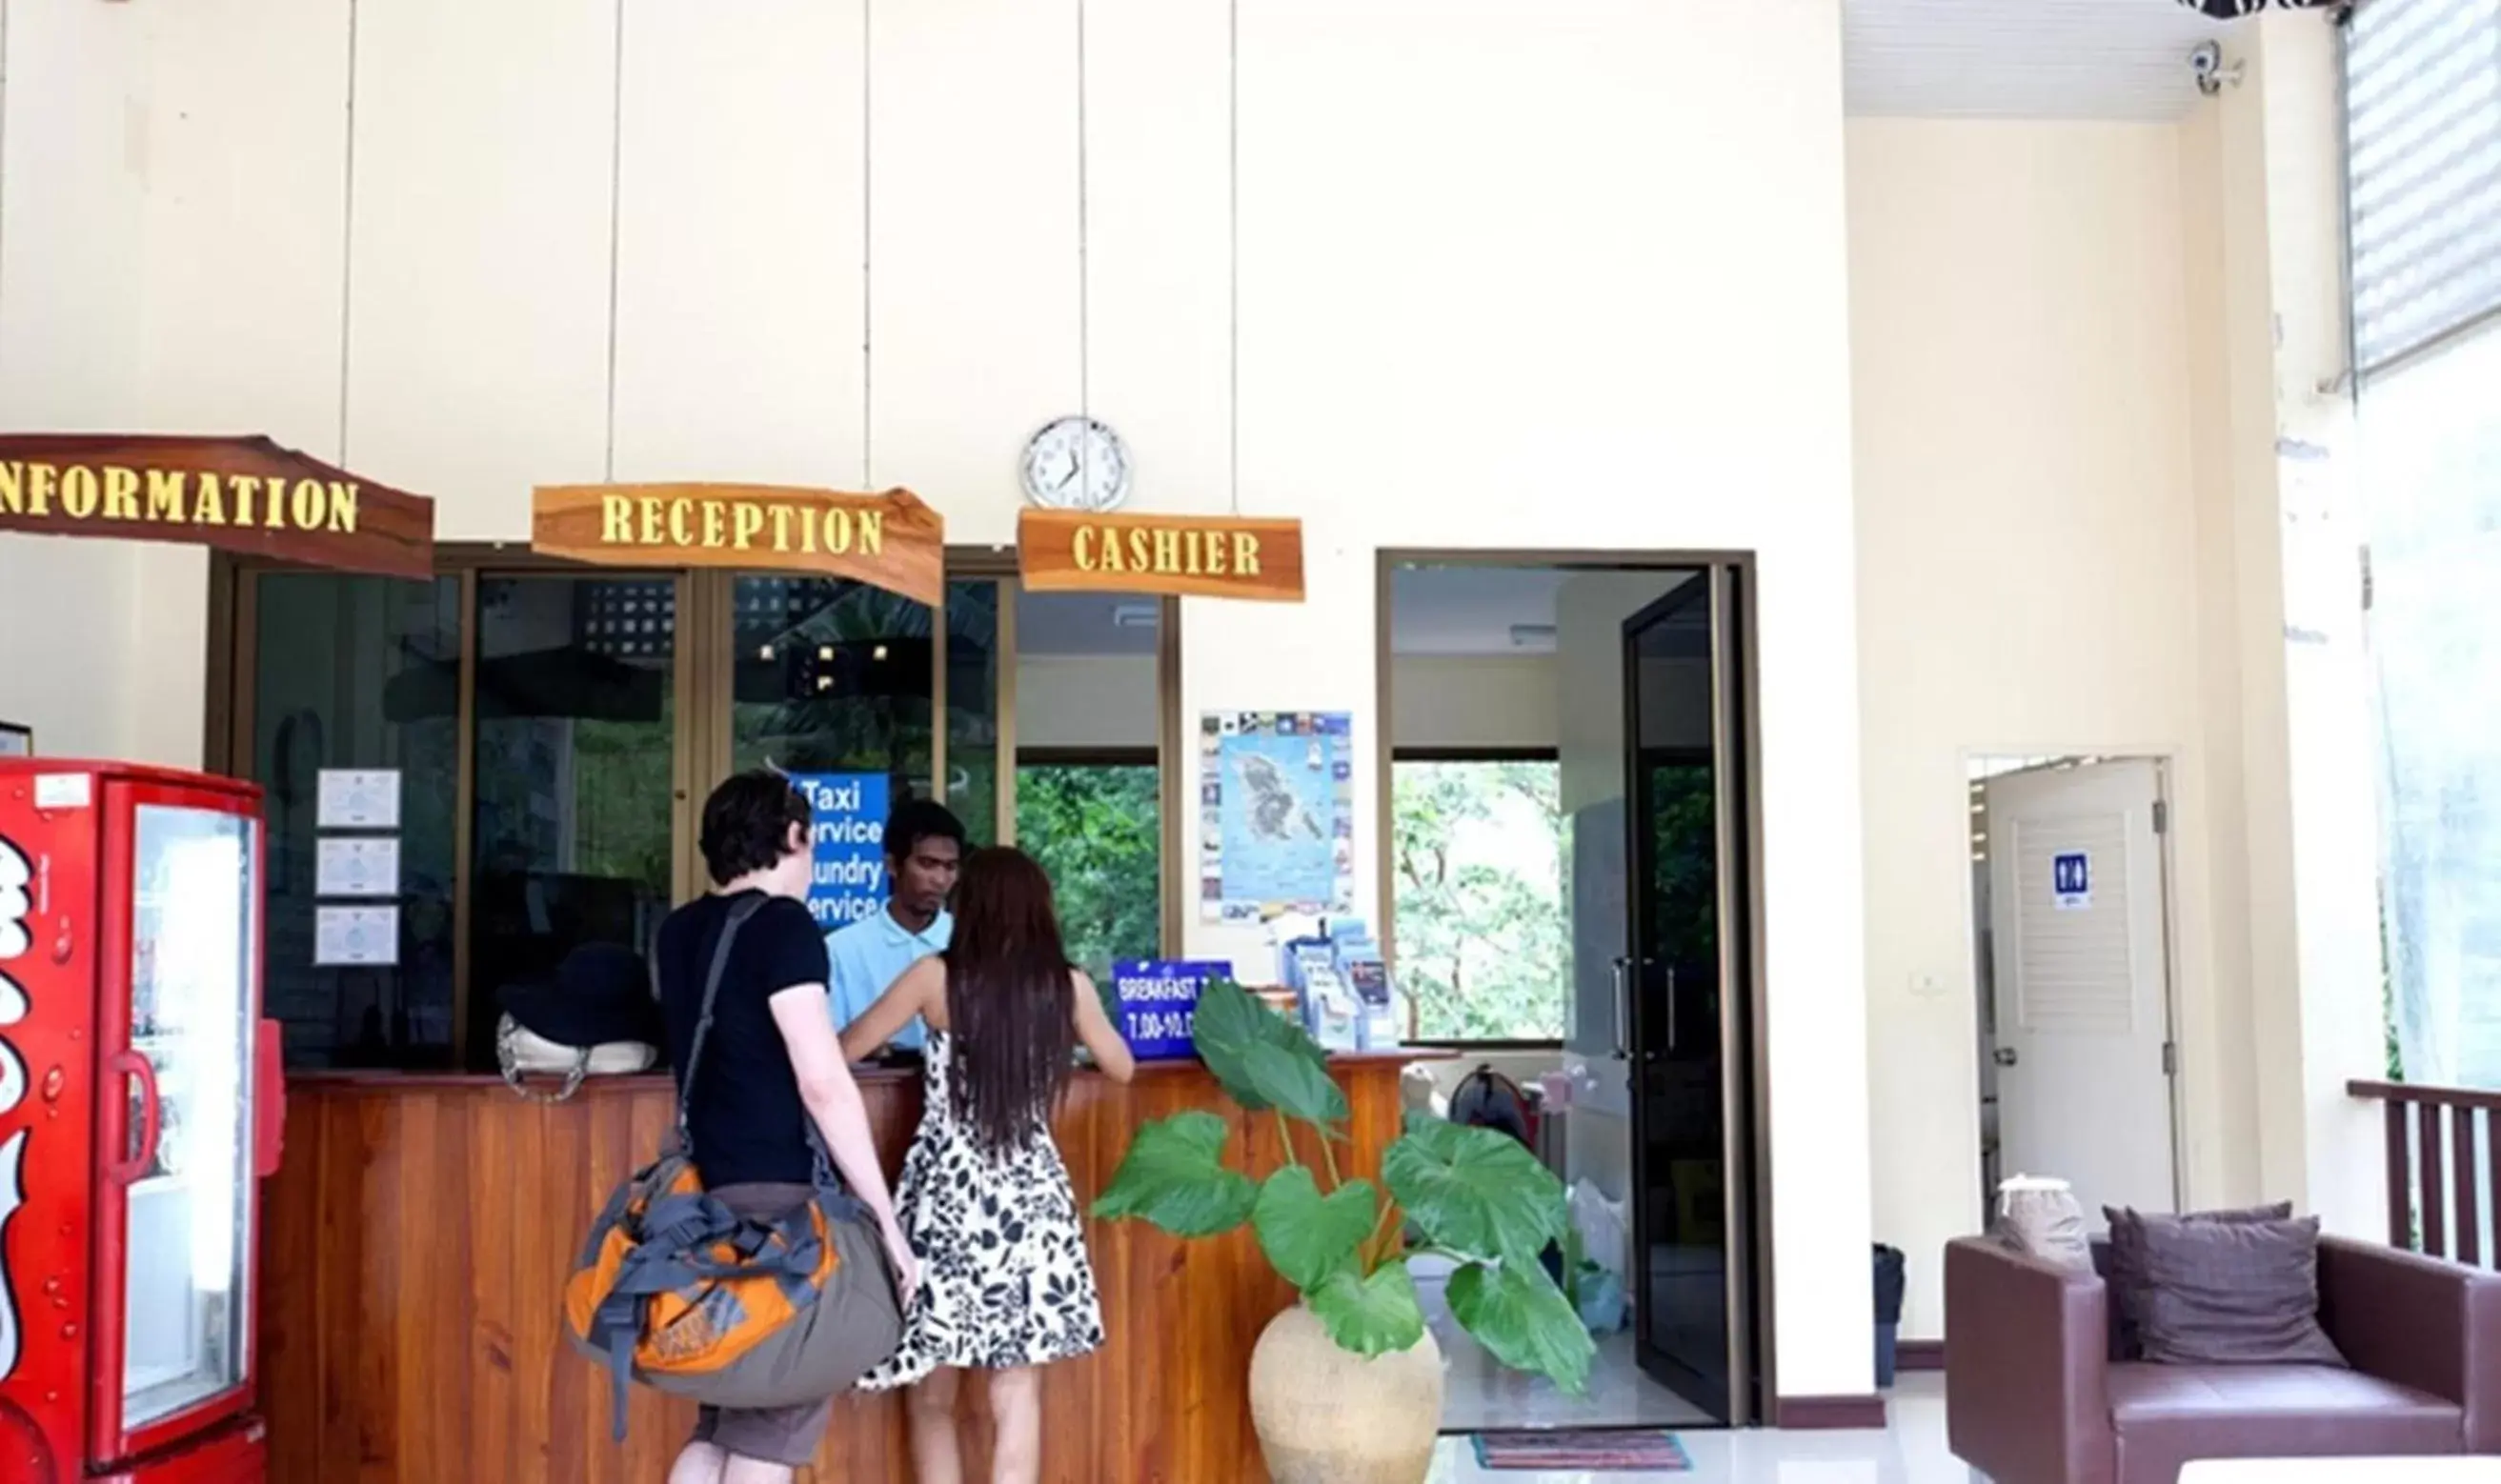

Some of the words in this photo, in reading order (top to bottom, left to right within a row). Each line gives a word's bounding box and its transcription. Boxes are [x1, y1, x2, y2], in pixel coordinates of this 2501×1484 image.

[601, 494, 883, 555] RECEPTION
[1073, 525, 1260, 575] CASHIER
[800, 780, 860, 811] Taxi
[1118, 976, 1197, 1001] BREAKFAST
